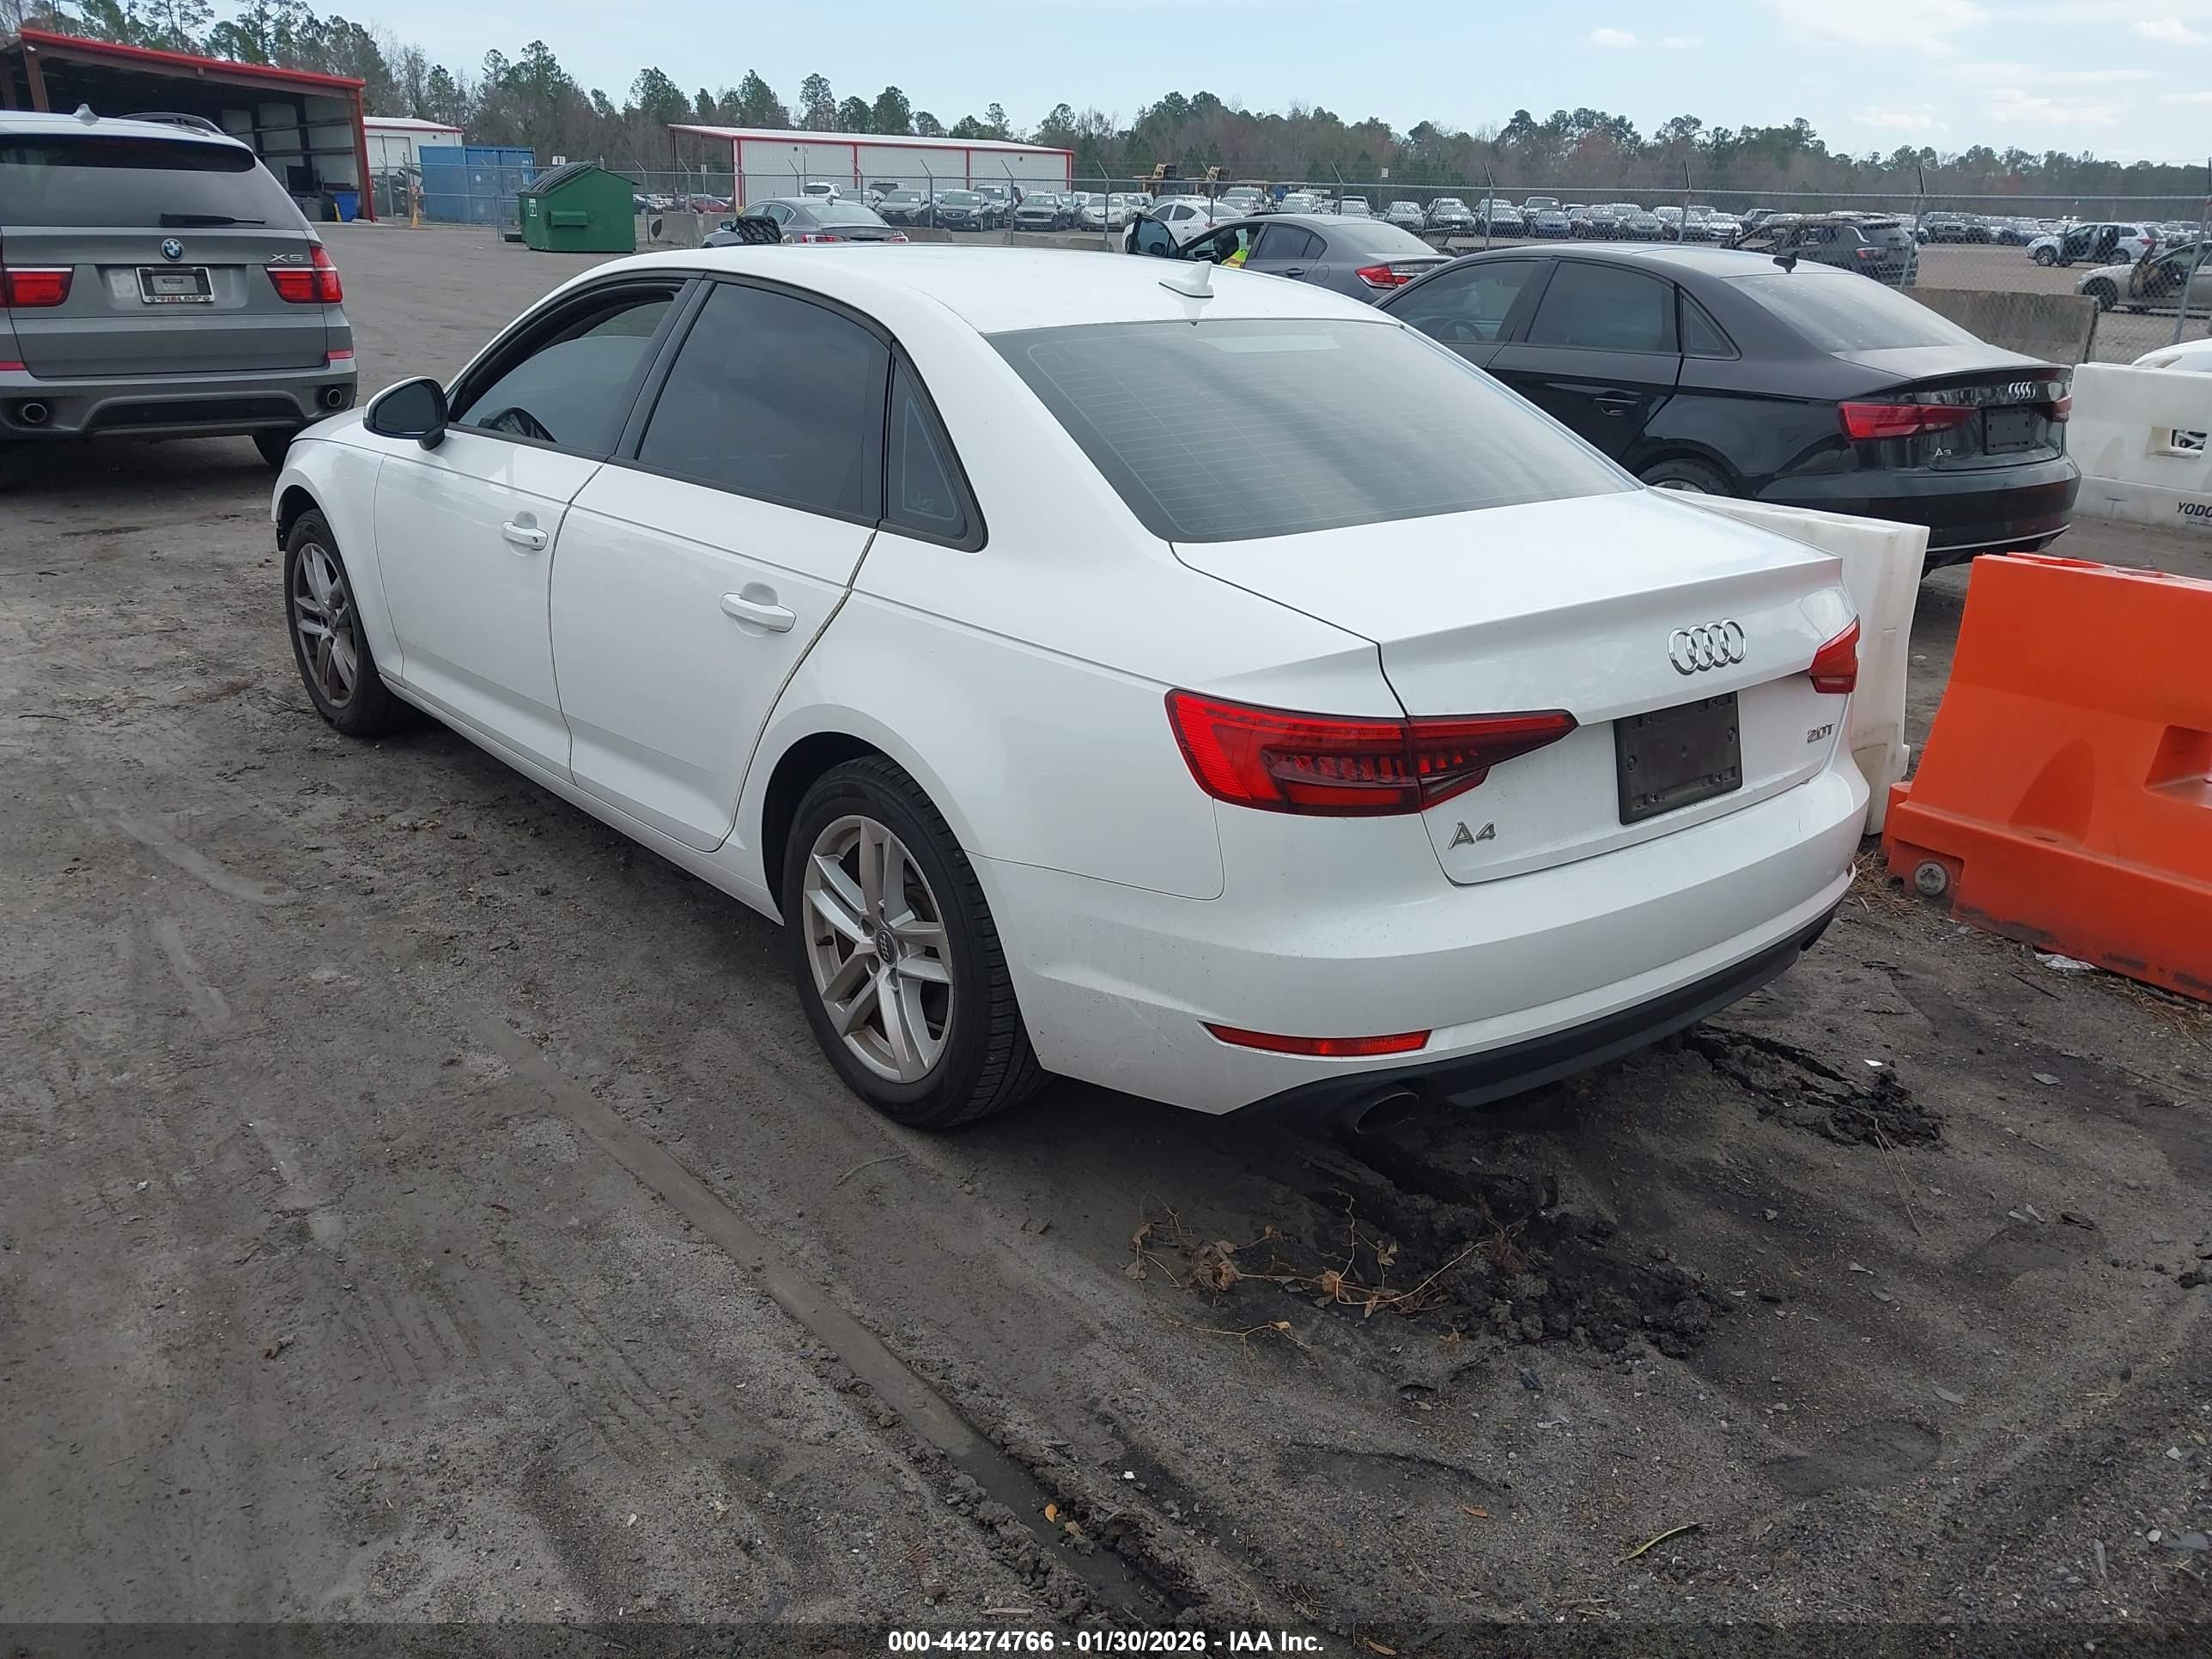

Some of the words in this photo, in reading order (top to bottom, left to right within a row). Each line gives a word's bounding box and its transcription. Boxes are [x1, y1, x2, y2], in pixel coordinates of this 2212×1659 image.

[269, 253, 304, 263] X5
[1934, 447, 1952, 458] A3
[1448, 821, 1496, 850] A4
